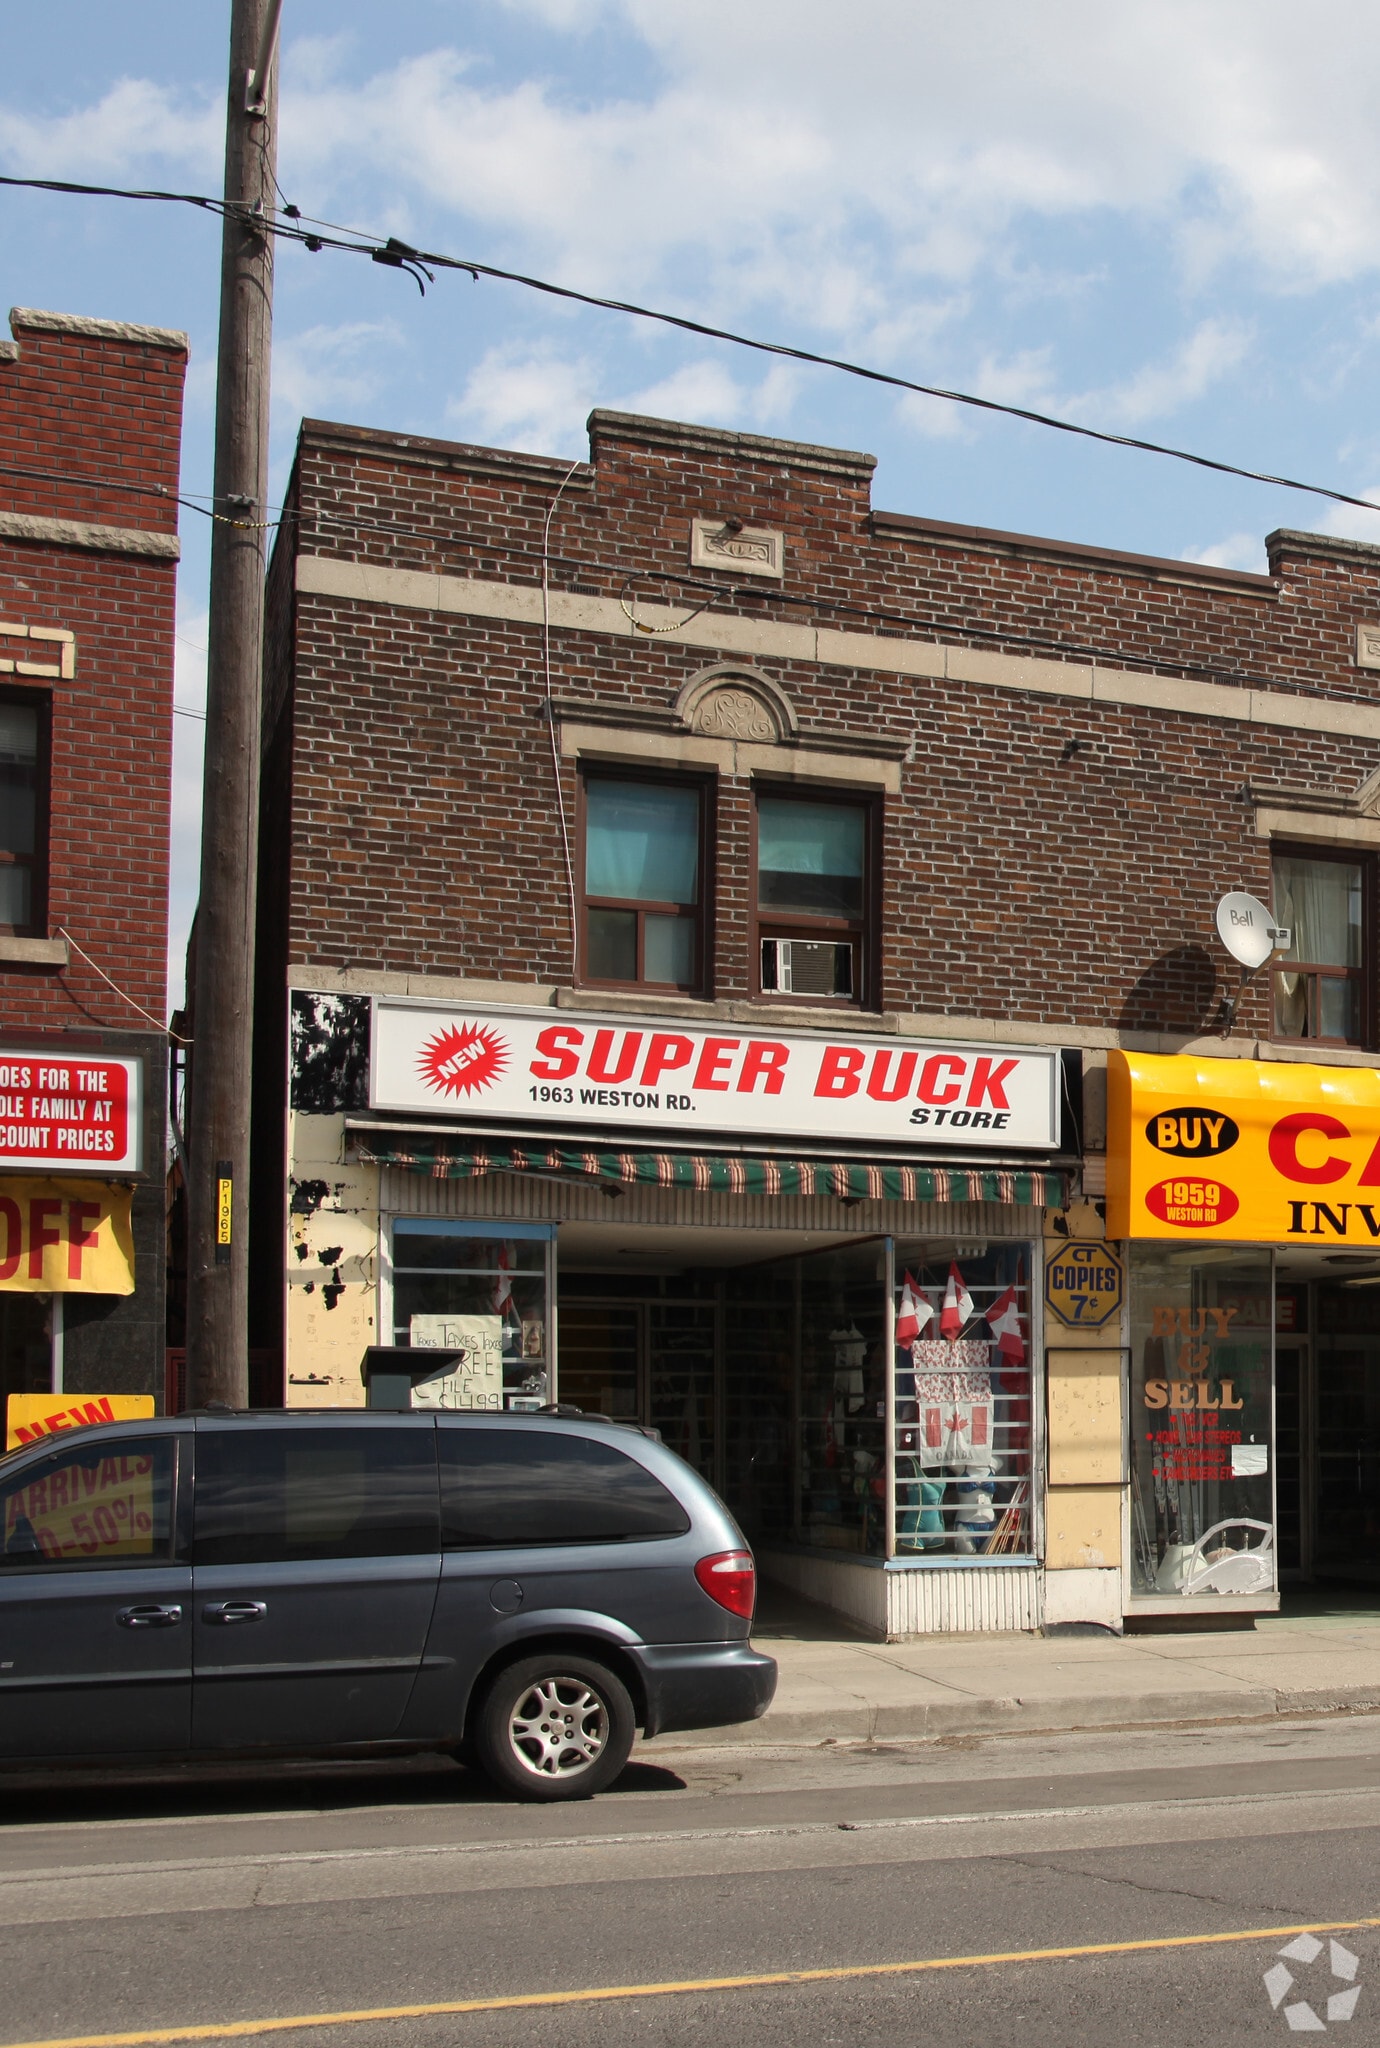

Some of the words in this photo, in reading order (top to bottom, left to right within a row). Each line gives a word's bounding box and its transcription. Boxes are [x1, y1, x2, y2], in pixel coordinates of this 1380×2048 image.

[1230, 909, 1254, 927] Bell
[437, 1038, 486, 1080] NEW
[529, 1026, 790, 1095] SUPER
[813, 1046, 1020, 1110] BUCK
[0, 1065, 31, 1089] OES
[39, 1068, 70, 1091] FOR
[77, 1070, 108, 1092] THE
[0, 1095, 24, 1118] OLE
[31, 1097, 87, 1121] FAMILY
[94, 1101, 113, 1122] AT
[529, 1085, 574, 1103] 1963
[579, 1089, 659, 1109] WESTON
[666, 1094, 696, 1111] RD.
[909, 1108, 1011, 1129] STORE
[0, 1125, 50, 1149] COUNT
[57, 1129, 115, 1152] PRICES
[1157, 1117, 1225, 1149] BUY
[1268, 1112, 1380, 1187] C
[1162, 1182, 1220, 1206] 1959
[220, 1180, 230, 1242] P1965
[1167, 1207, 1203, 1222] WESTON
[1205, 1208, 1217, 1222] RD
[0, 1196, 101, 1281] OFF
[1072, 1248, 1097, 1262] CT
[1053, 1266, 1116, 1292] COPIES
[1151, 1306, 1239, 1338] BUY
[437, 1323, 479, 1350] TAXES
[459, 1349, 495, 1376] REE
[1177, 1343, 1211, 1374] &
[1144, 1379, 1244, 1409] SELL
[1204, 1430, 1242, 1444] STEREOS
[7, 1454, 152, 1528] ARRIVALS
